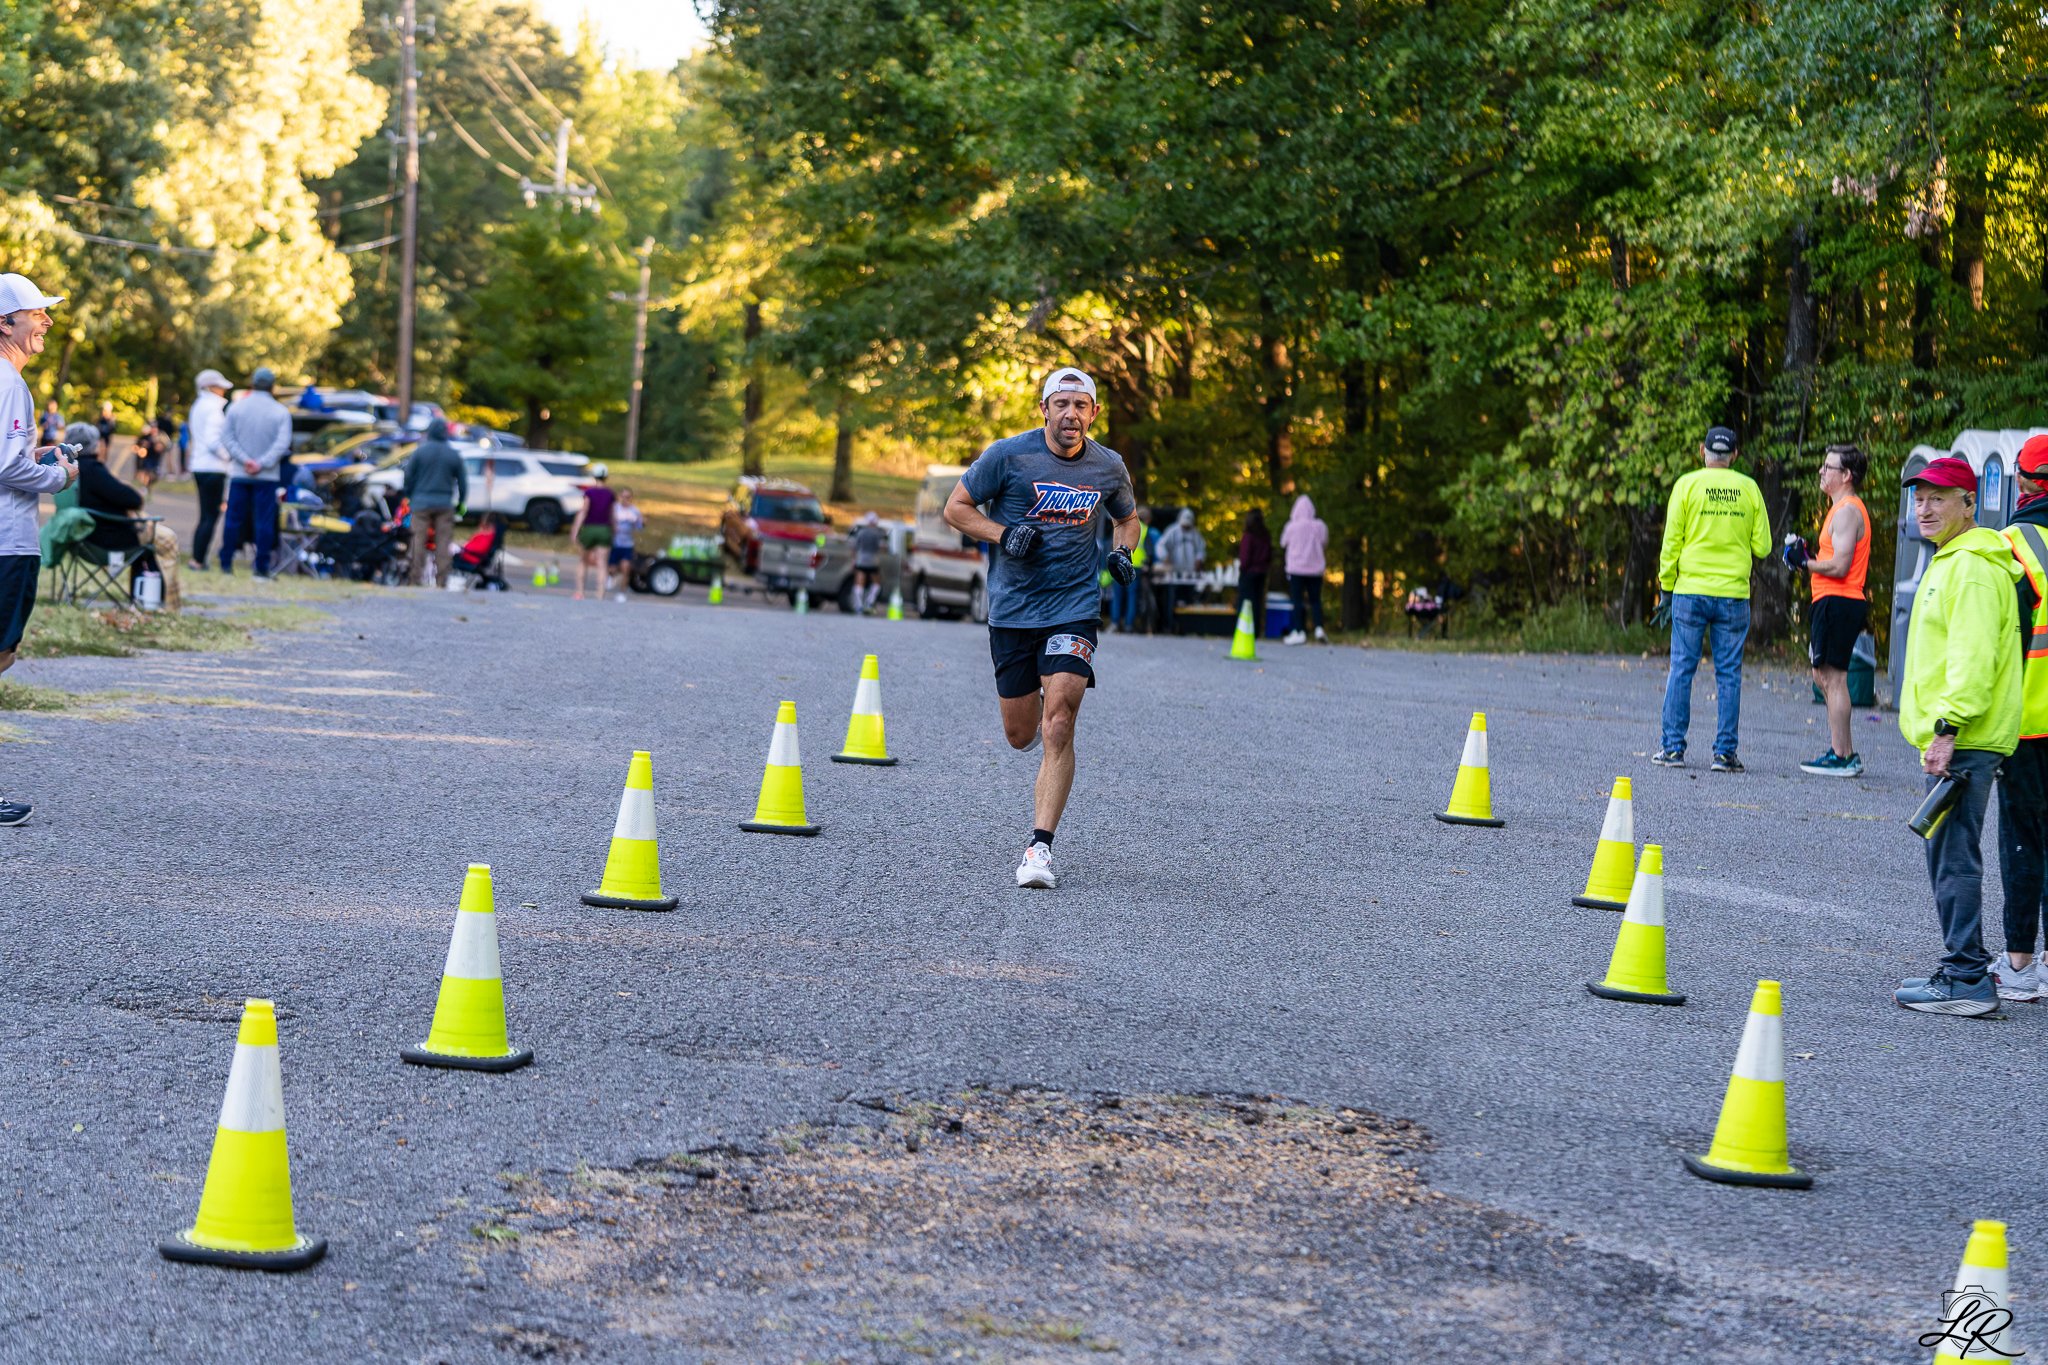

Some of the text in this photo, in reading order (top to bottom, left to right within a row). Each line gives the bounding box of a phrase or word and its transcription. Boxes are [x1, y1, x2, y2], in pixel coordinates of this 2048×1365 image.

[1026, 482, 1101, 517] THUNDER
[1706, 488, 1741, 496] MEMPHIS
[1070, 642, 1092, 664] 246
